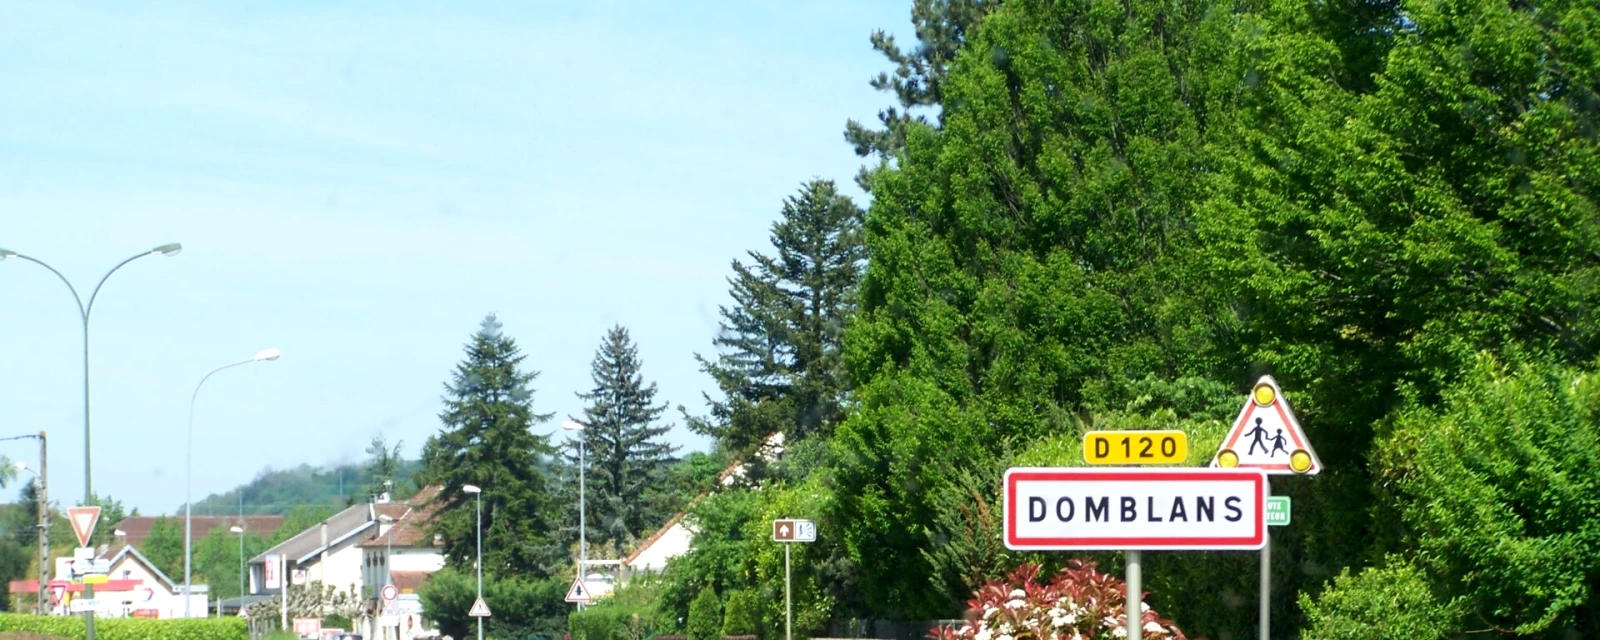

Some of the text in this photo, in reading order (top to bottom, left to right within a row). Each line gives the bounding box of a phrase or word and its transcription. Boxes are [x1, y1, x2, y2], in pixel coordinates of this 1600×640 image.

[1095, 436, 1177, 459] D 120
[1028, 495, 1244, 523] DOMBLANS
